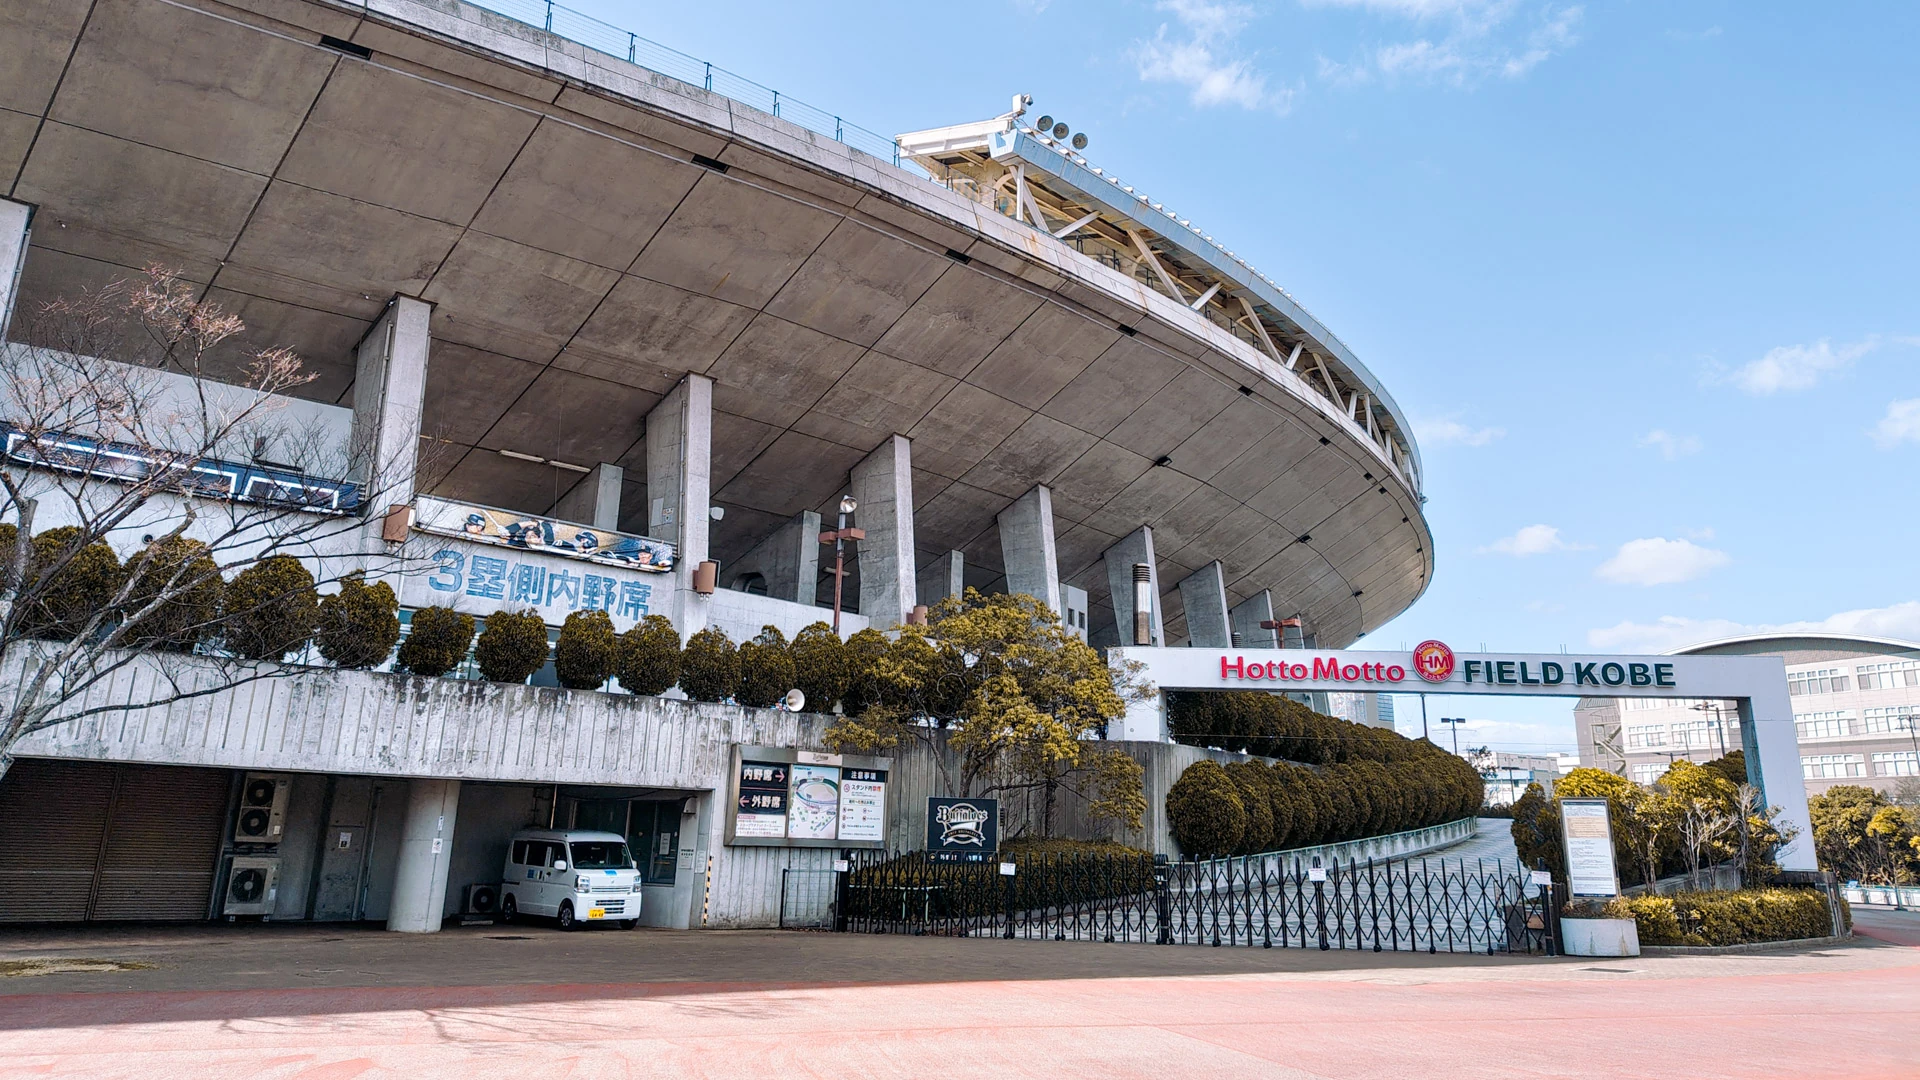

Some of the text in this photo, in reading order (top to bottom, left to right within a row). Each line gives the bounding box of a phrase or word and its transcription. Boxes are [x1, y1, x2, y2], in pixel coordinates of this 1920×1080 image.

[428, 549, 652, 621] 3塁側内野席
[1417, 642, 1450, 655] Hotto Motto
[1419, 655, 1450, 669] HM
[1220, 656, 1677, 687] Hotto Motto FIELD KOBE
[743, 768, 773, 781] 内野席
[850, 770, 877, 780] 注意事項
[751, 795, 781, 808] 外野席
[936, 806, 988, 823] Buffaloes
